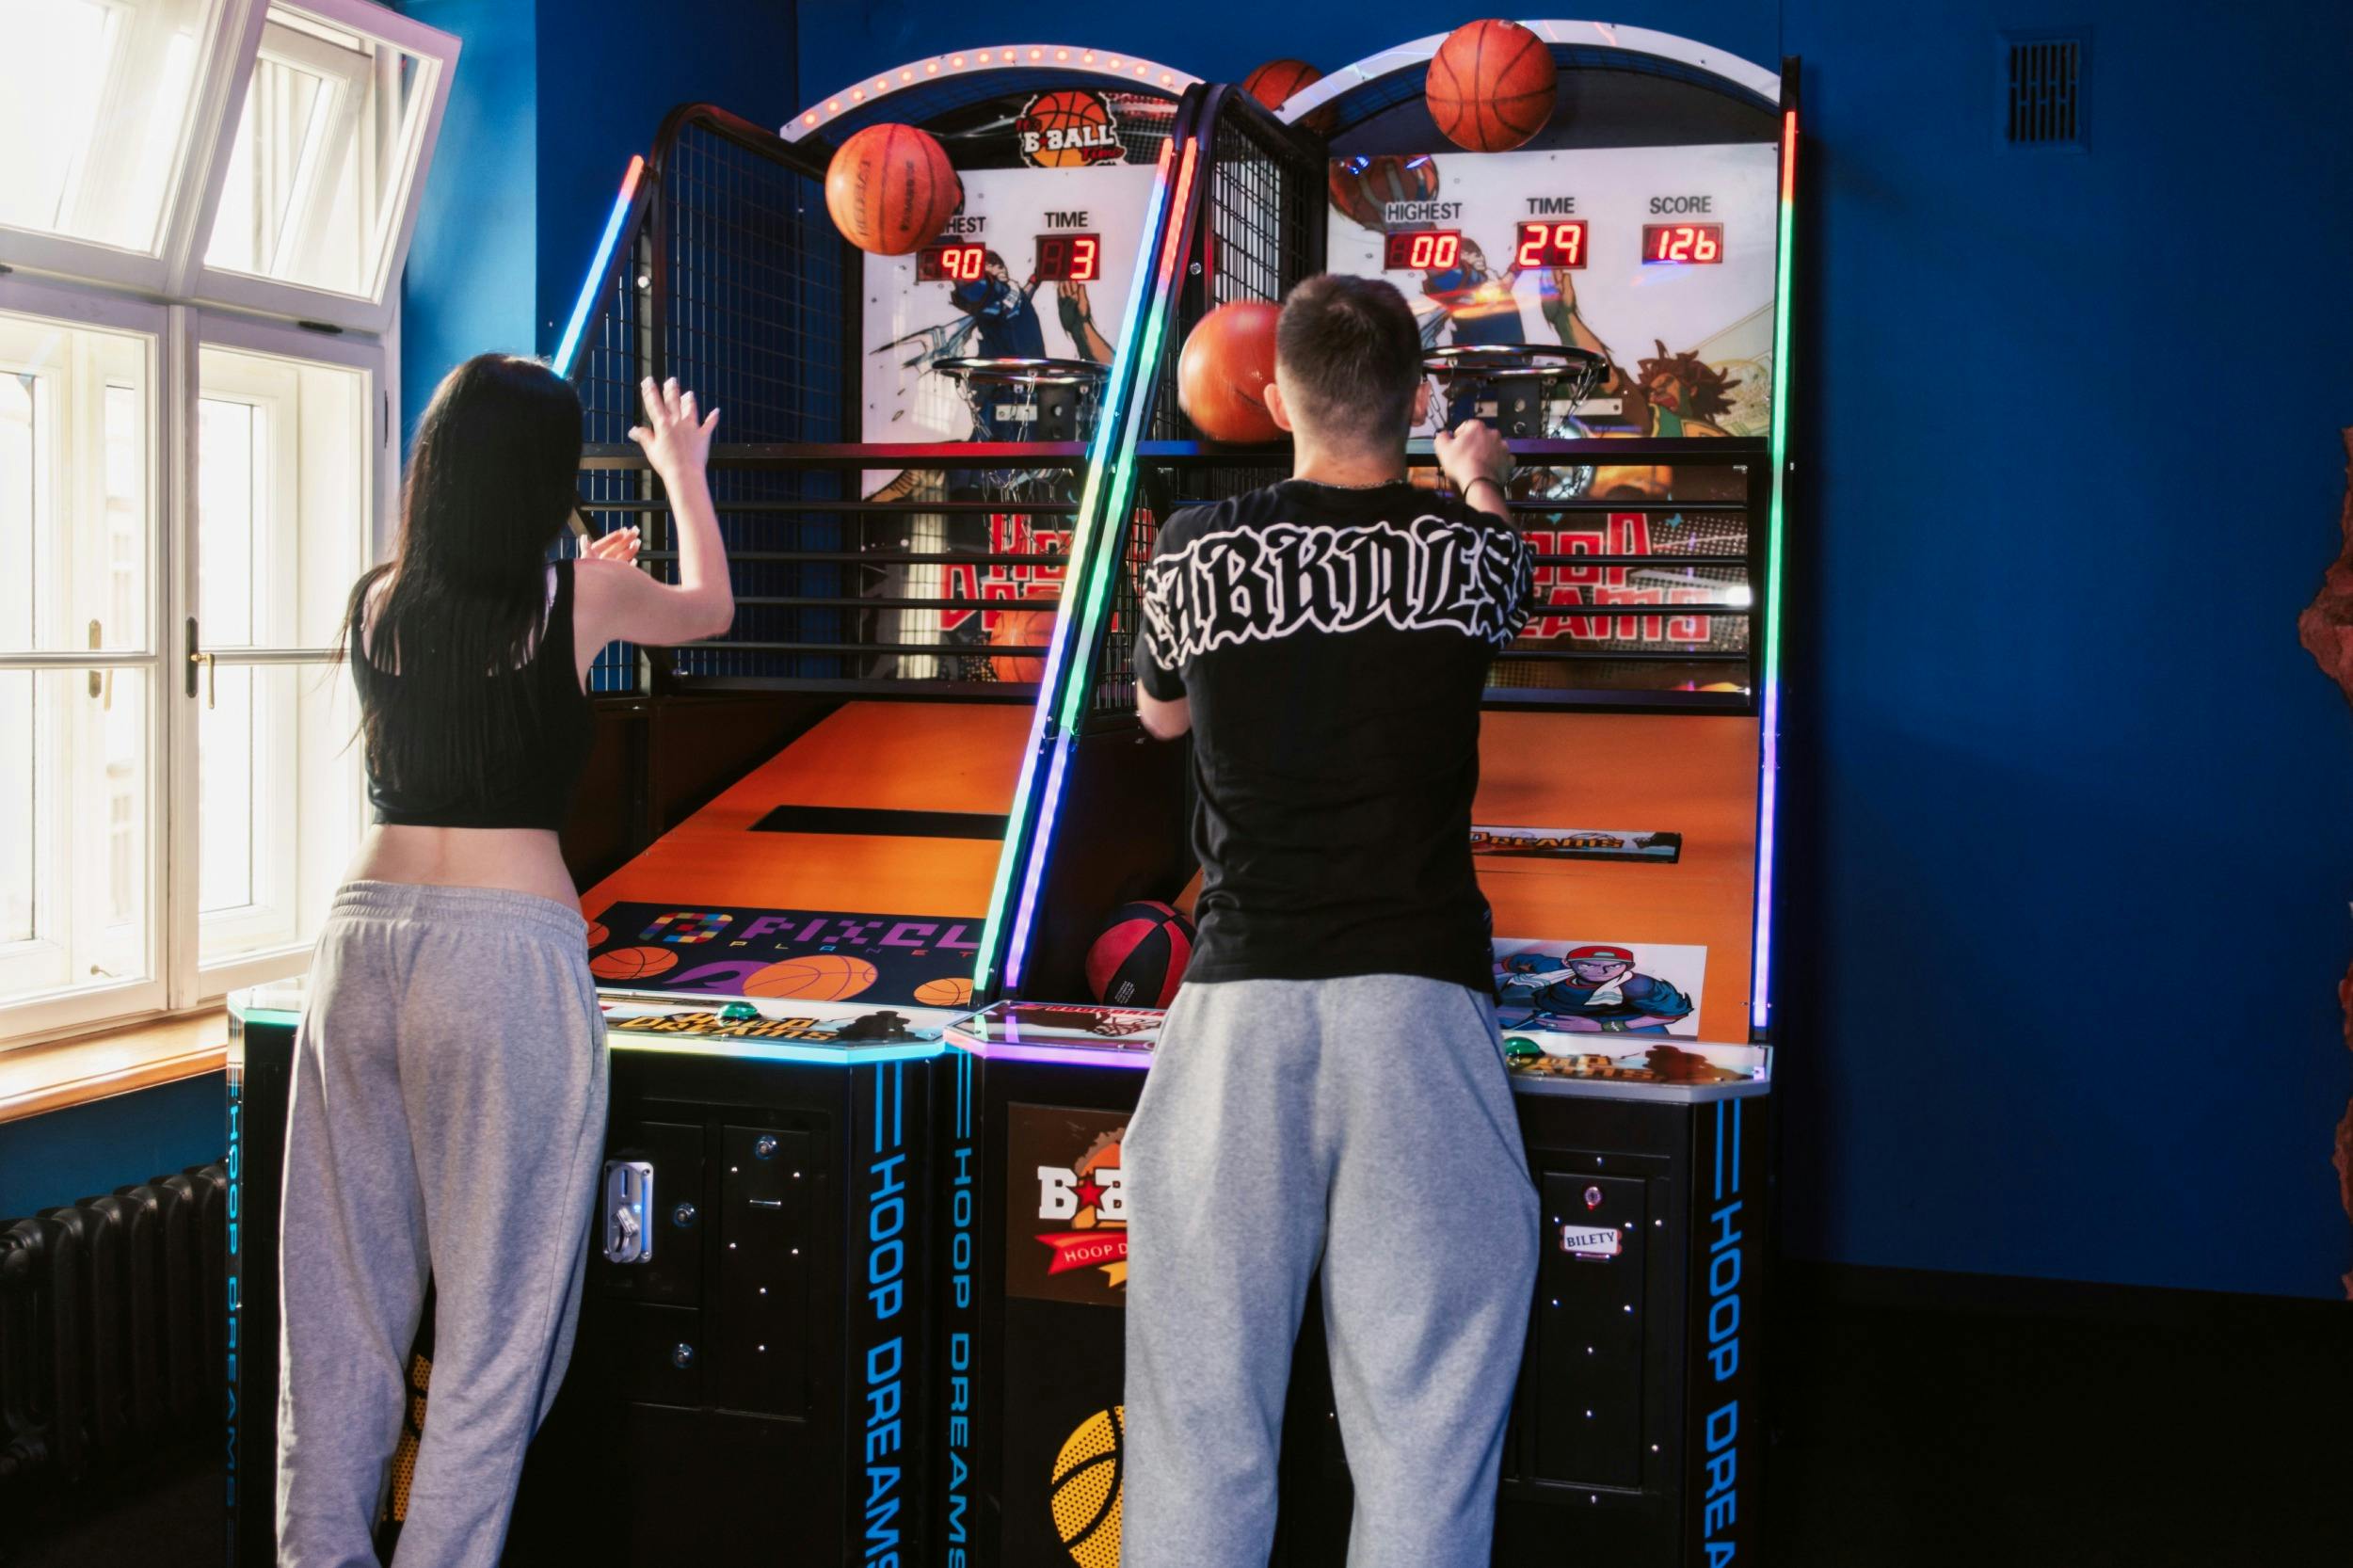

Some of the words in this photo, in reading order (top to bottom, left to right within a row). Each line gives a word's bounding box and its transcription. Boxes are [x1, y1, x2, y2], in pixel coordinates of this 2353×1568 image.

[1044, 211, 1088, 228] TIME
[1385, 202, 1462, 221] HIGHEST
[1527, 197, 1575, 215] TIME
[1649, 196, 1712, 214] SCORE
[945, 216, 986, 233] HEST
[1519, 224, 1580, 266] 29
[942, 248, 983, 279] 90
[739, 916, 980, 949] PIXEL
[729, 942, 973, 958] PLANET
[230, 1105, 238, 1255] HOOP
[868, 1153, 905, 1320] HOOP
[952, 1148, 972, 1308] HOOP
[1566, 1231, 1614, 1247] BILETY
[1064, 1243, 1113, 1262] HOOP
[1708, 1200, 1743, 1383] HOOP
[228, 1276, 237, 1507] DREAMS
[1705, 1400, 1738, 1568] DREA
